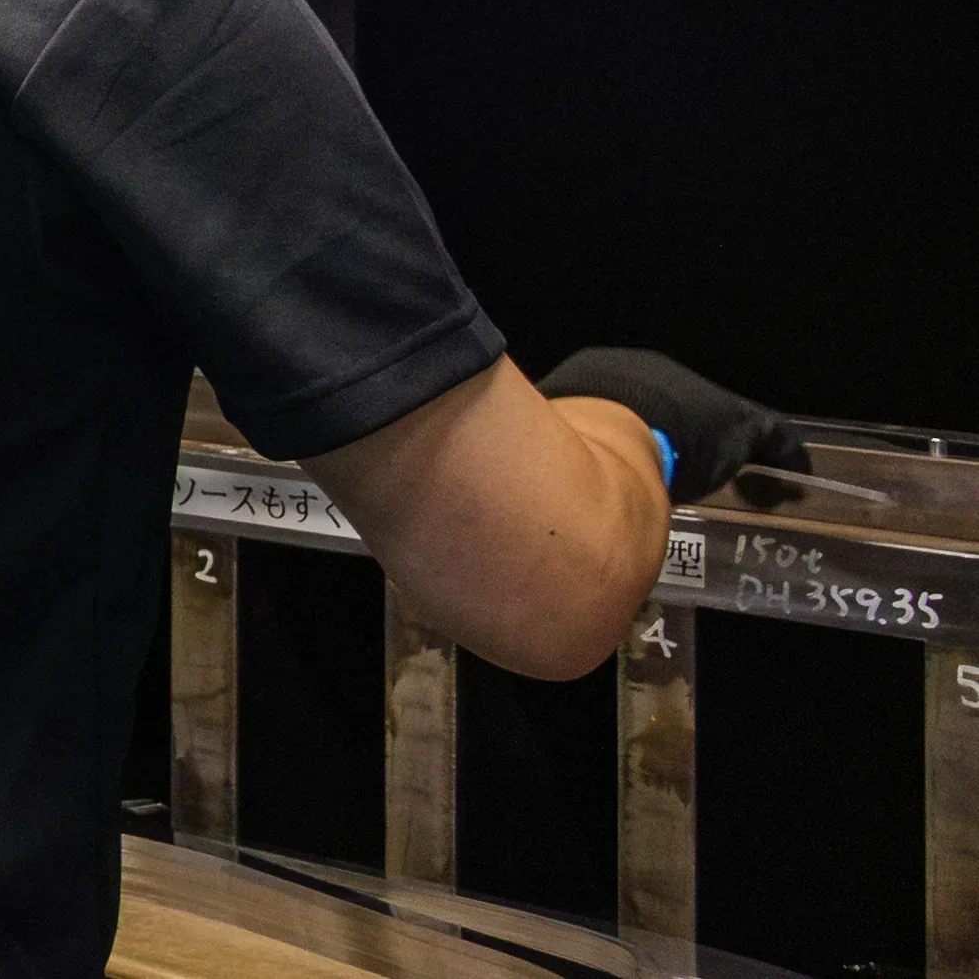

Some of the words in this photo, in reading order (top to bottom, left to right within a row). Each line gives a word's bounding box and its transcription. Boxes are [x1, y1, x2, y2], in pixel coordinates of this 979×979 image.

[194, 548, 218, 584] 2
[665, 538, 704, 580] 型
[805, 578, 944, 630] 359.35
[639, 617, 678, 658] 4
[956, 664, 979, 709] 5
